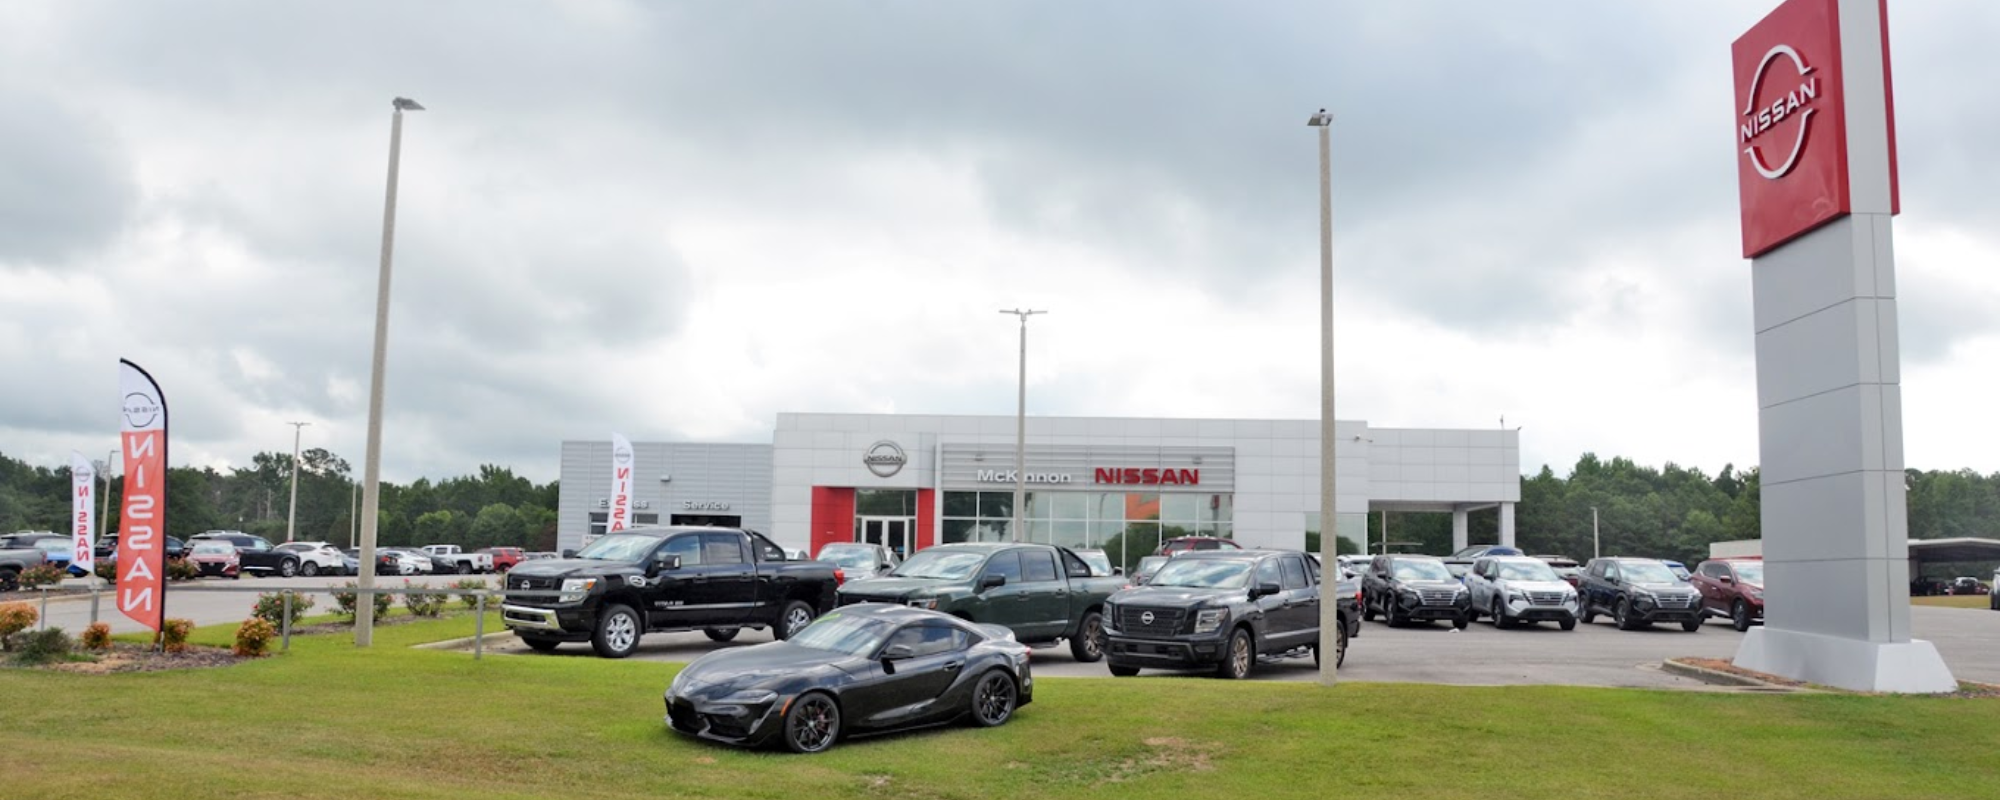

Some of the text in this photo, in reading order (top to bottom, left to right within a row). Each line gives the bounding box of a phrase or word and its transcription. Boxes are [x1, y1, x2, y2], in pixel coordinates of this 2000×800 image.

[1741, 77, 1815, 143] NISSAN
[977, 468, 1199, 485] McKnnon NISSAN
[683, 500, 730, 511] Service
